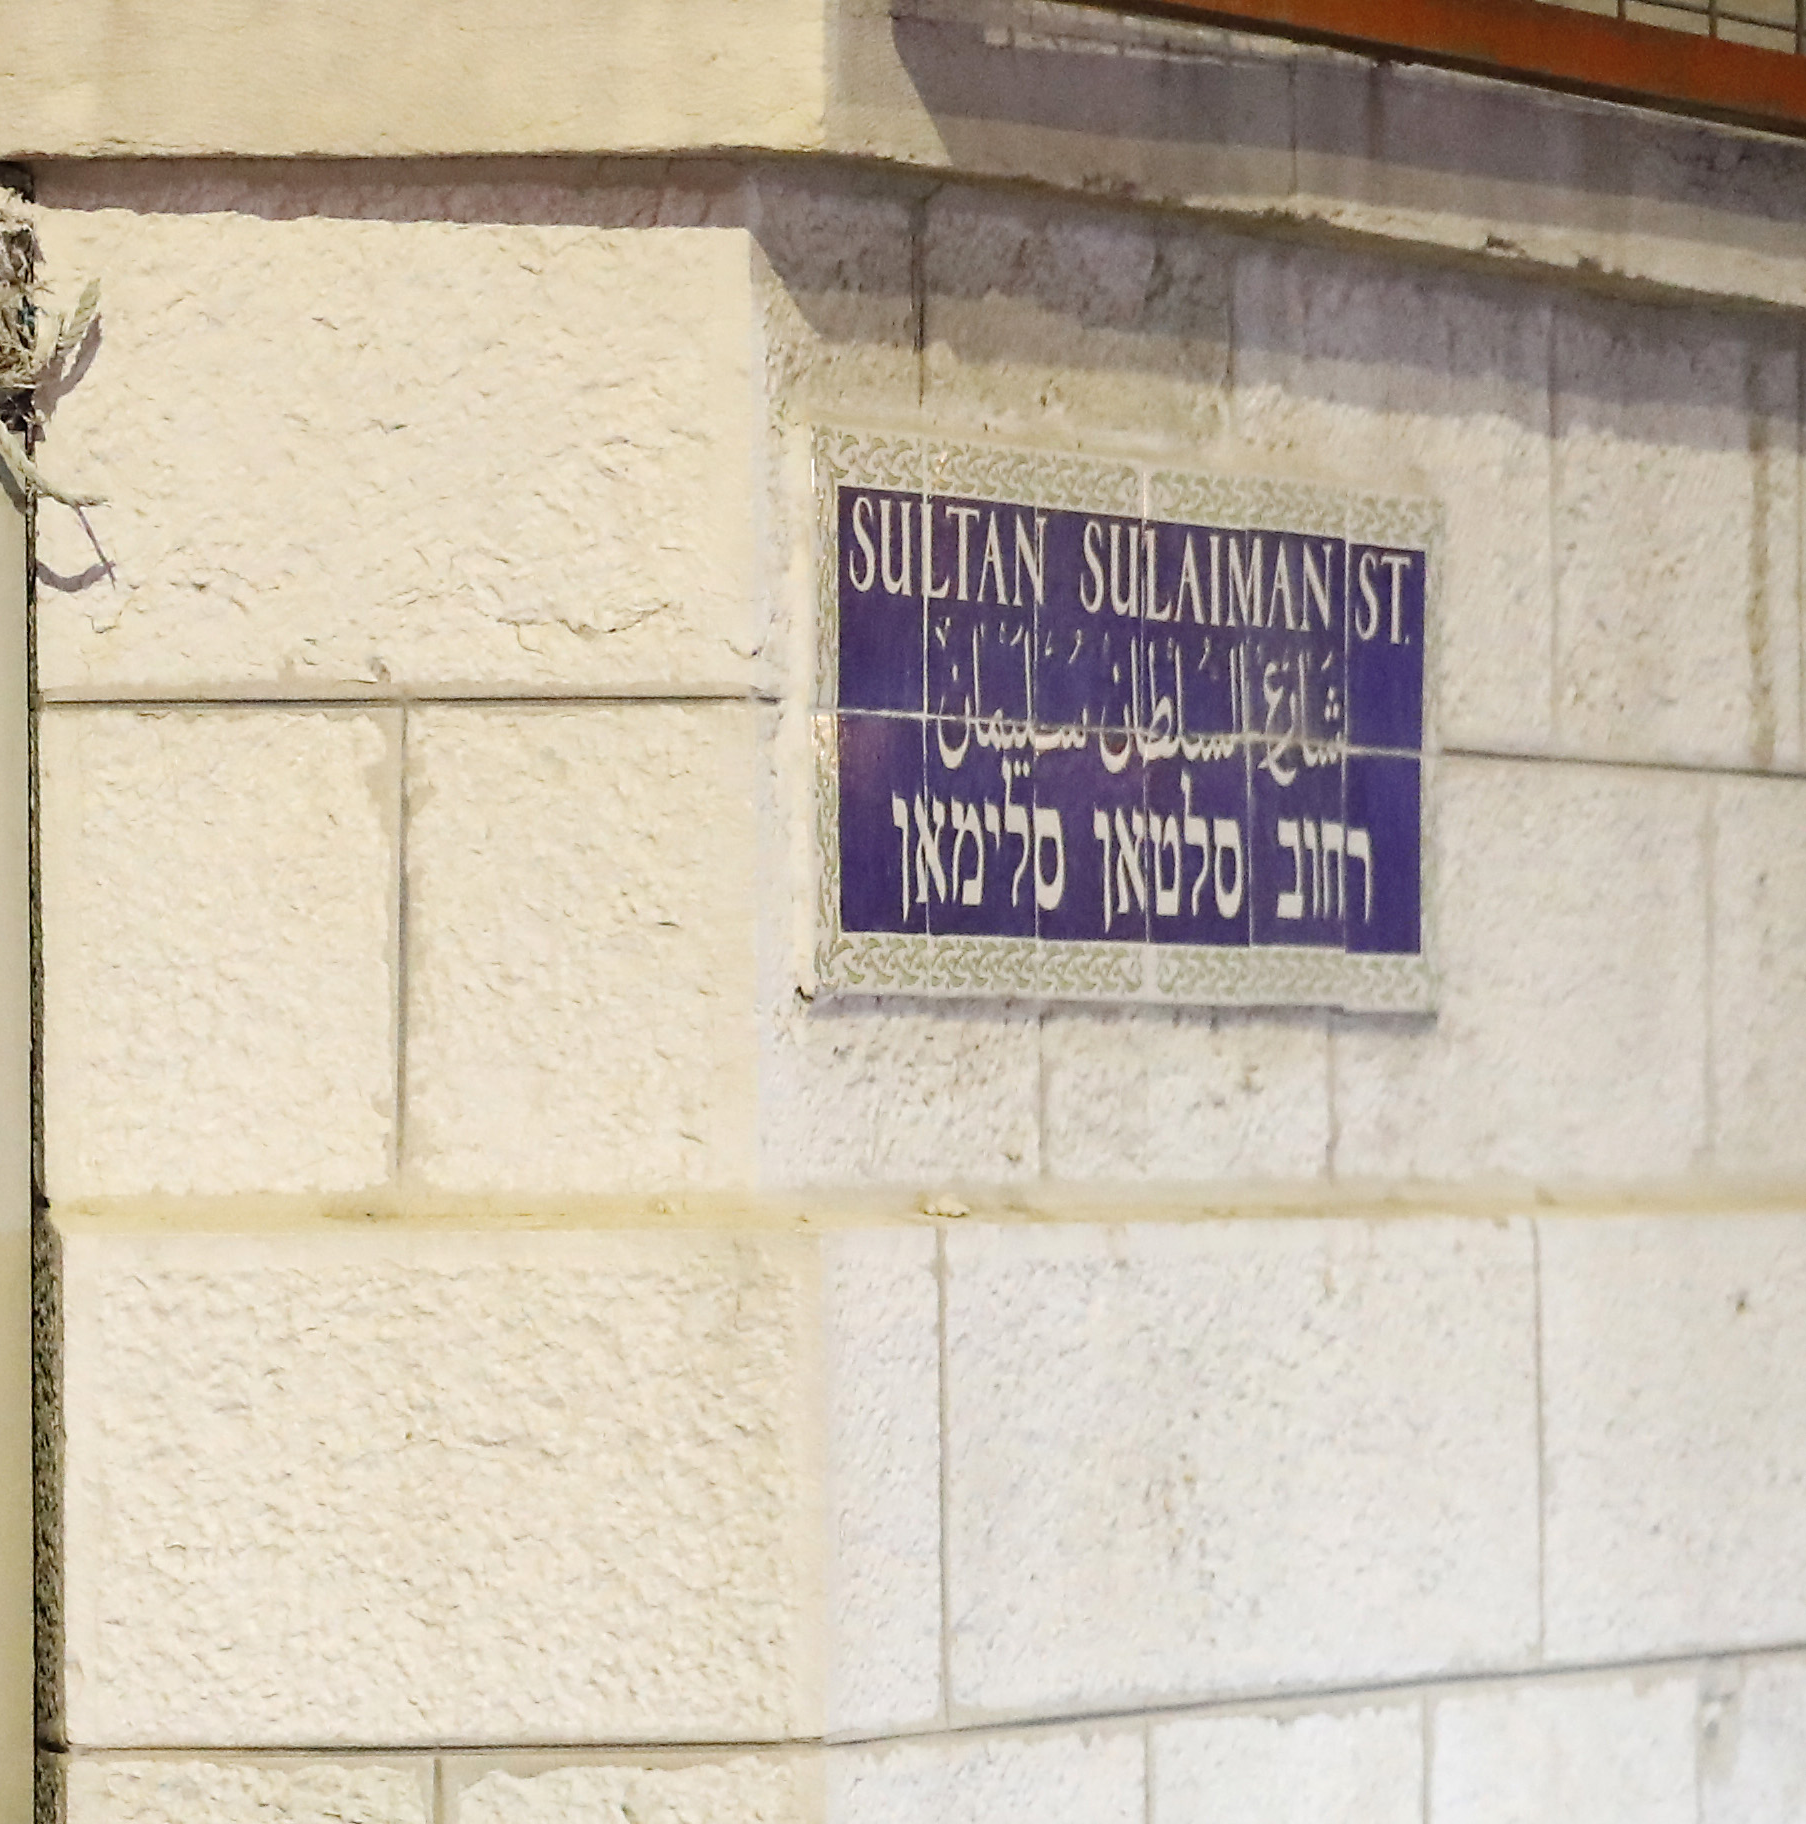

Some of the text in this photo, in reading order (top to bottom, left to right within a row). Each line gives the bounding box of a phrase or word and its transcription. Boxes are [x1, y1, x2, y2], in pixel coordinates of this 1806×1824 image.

[849, 496, 1412, 645] SULTAN SULAIMAN ST.
[891, 763, 1373, 933] רחוב סלטאן סלימאן
